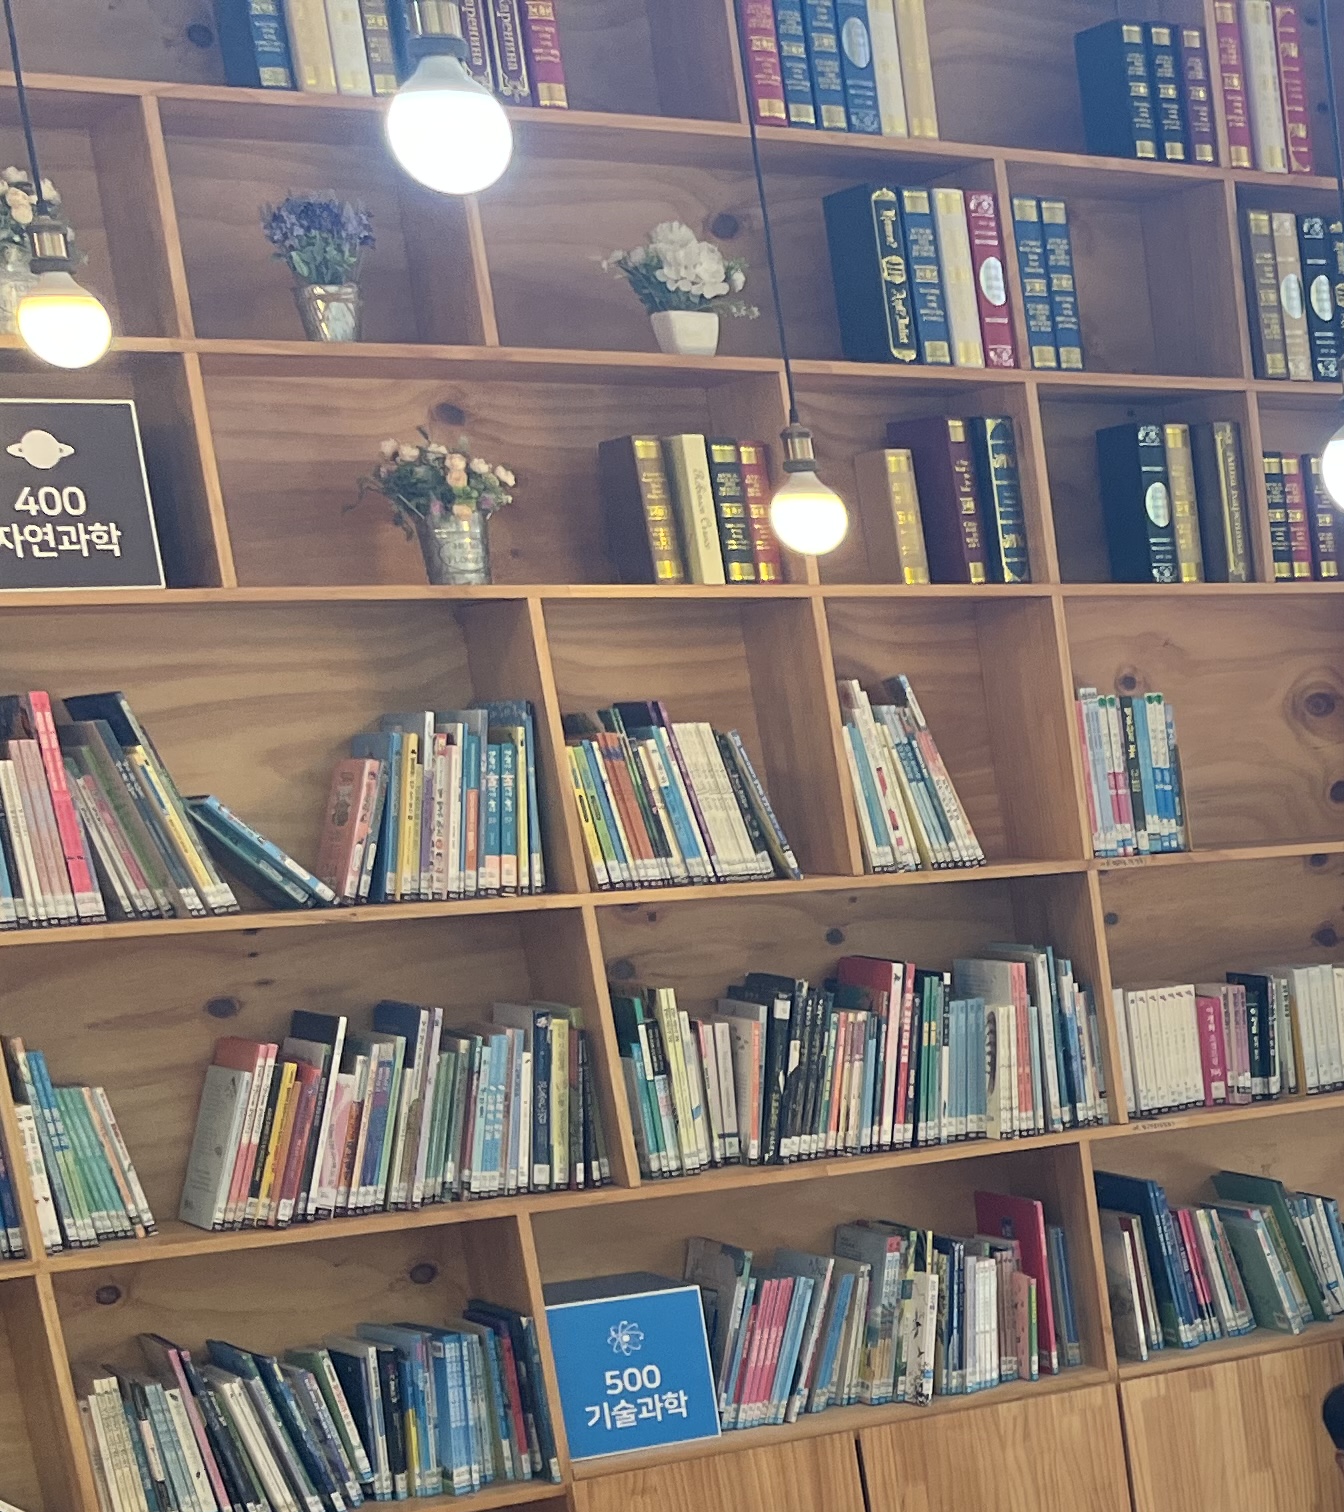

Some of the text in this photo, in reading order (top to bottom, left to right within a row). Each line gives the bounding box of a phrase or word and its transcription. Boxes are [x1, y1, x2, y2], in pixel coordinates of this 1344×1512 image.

[462, 0, 483, 66] аренина
[14, 486, 87, 516] 400
[0, 522, 122, 558] 자연과학
[605, 1364, 662, 1395] 500
[585, 1389, 688, 1430] 기술과학
